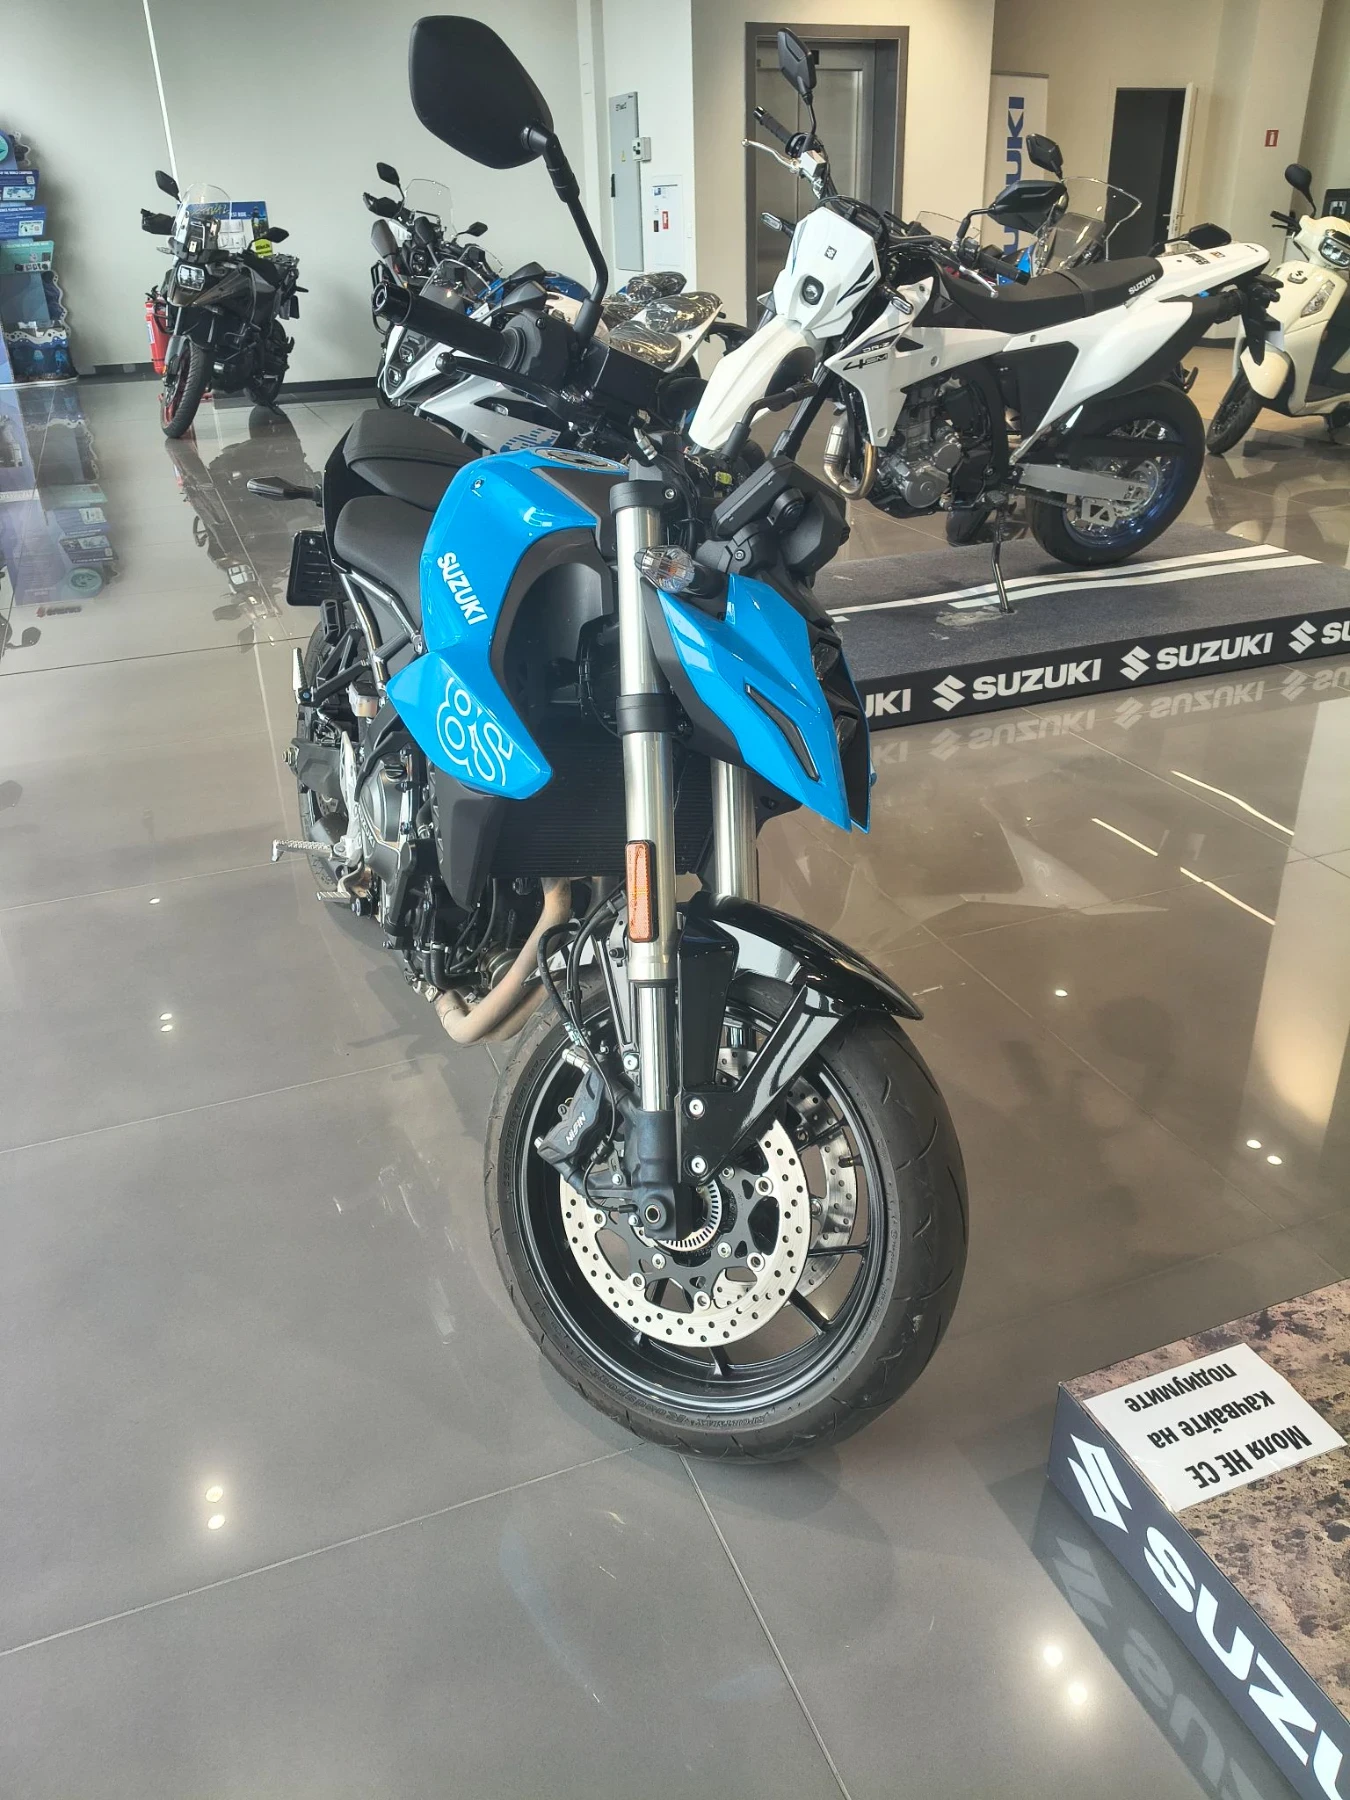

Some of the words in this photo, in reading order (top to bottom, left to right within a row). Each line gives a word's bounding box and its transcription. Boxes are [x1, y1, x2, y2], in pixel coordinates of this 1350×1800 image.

[1128, 274, 1156, 295] SUZUKI
[437, 551, 489, 625] SUZUKI
[1156, 632, 1274, 671] SUZUKI
[972, 658, 1102, 700] SUZUKI
[1124, 1364, 1237, 1412] подиумите
[1178, 1391, 1275, 1437] качвайте
[1147, 1427, 1180, 1449] на
[1245, 1426, 1312, 1461] Моля
[1185, 1462, 1220, 1489] СЕ
[1214, 1449, 1253, 1477] НЕ
